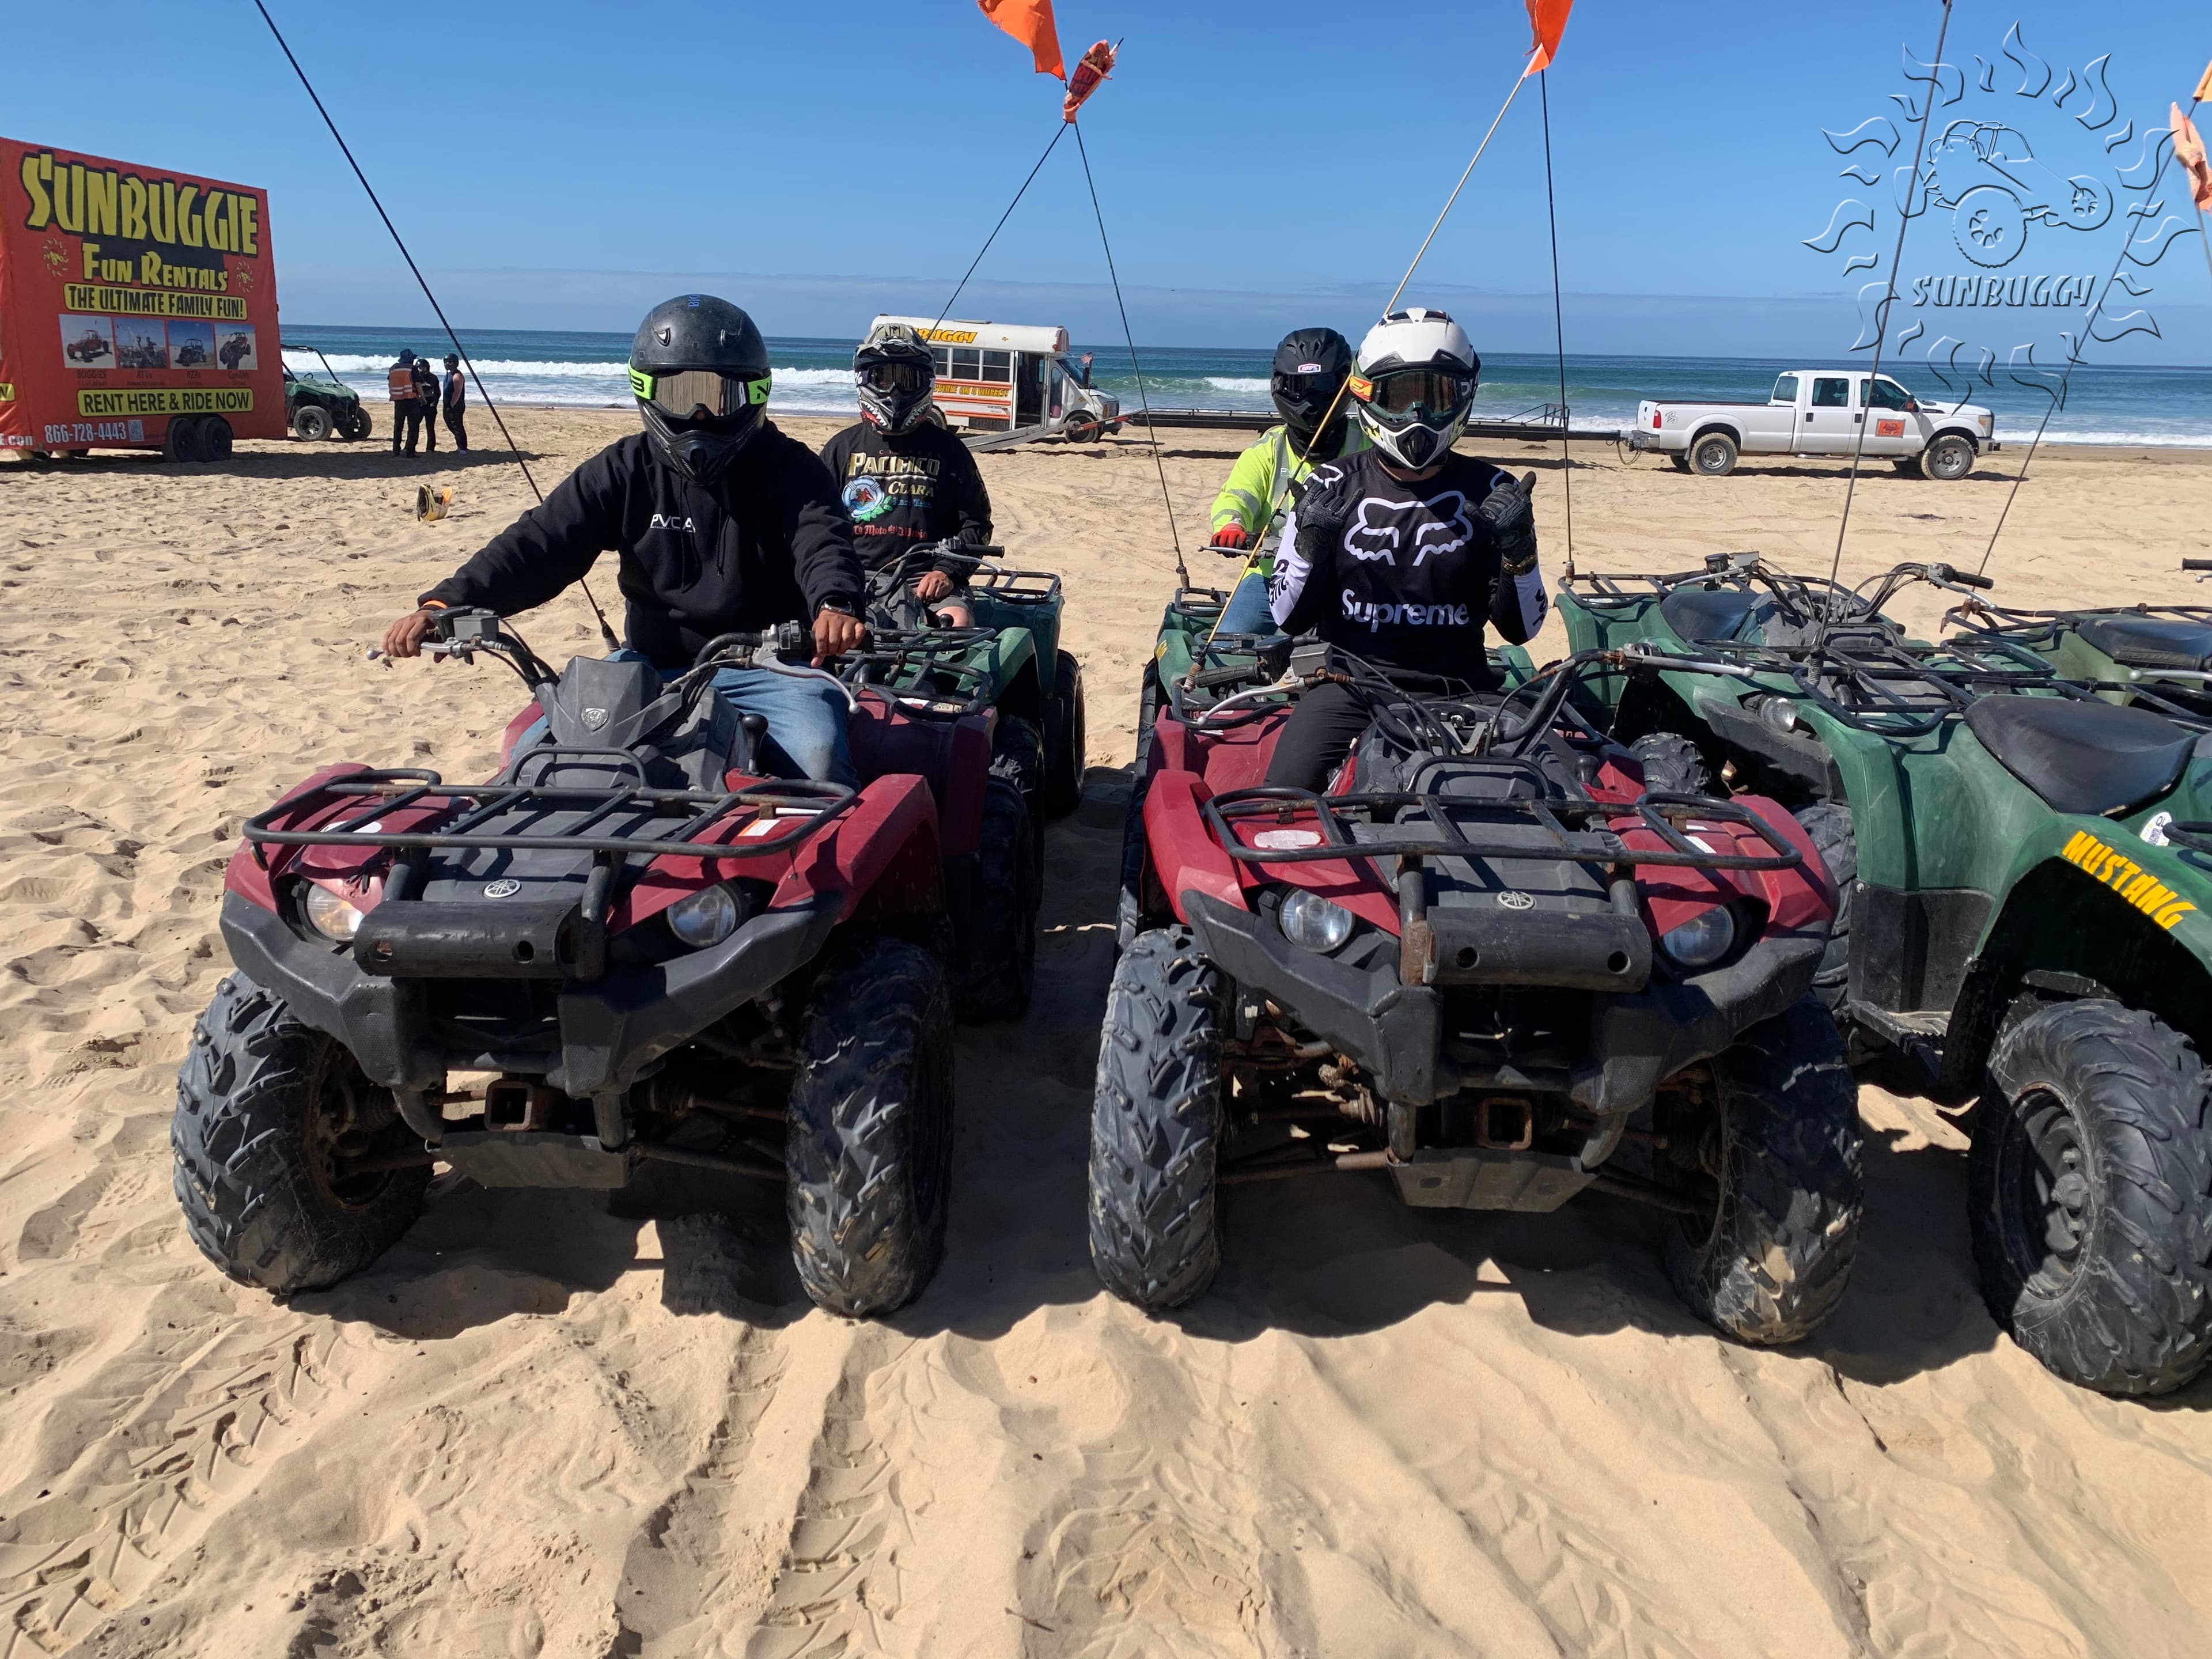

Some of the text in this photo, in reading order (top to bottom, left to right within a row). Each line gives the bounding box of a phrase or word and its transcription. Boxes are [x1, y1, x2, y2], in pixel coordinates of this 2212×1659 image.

[22, 153, 257, 255] SUNBUGGIE
[82, 243, 228, 291] FUN RENTALS
[69, 286, 244, 318] THE ULTIMATE FAMILY FUN!
[915, 328, 978, 343] BUGGY
[84, 392, 249, 413] RENT HERE & RIDE NOW
[44, 422, 126, 444] 866-728-4443
[848, 452, 940, 476] PACIFICO
[888, 481, 934, 497] CLARA
[1342, 588, 1471, 632] Supreme
[2062, 830, 2198, 930] MUSTANG
